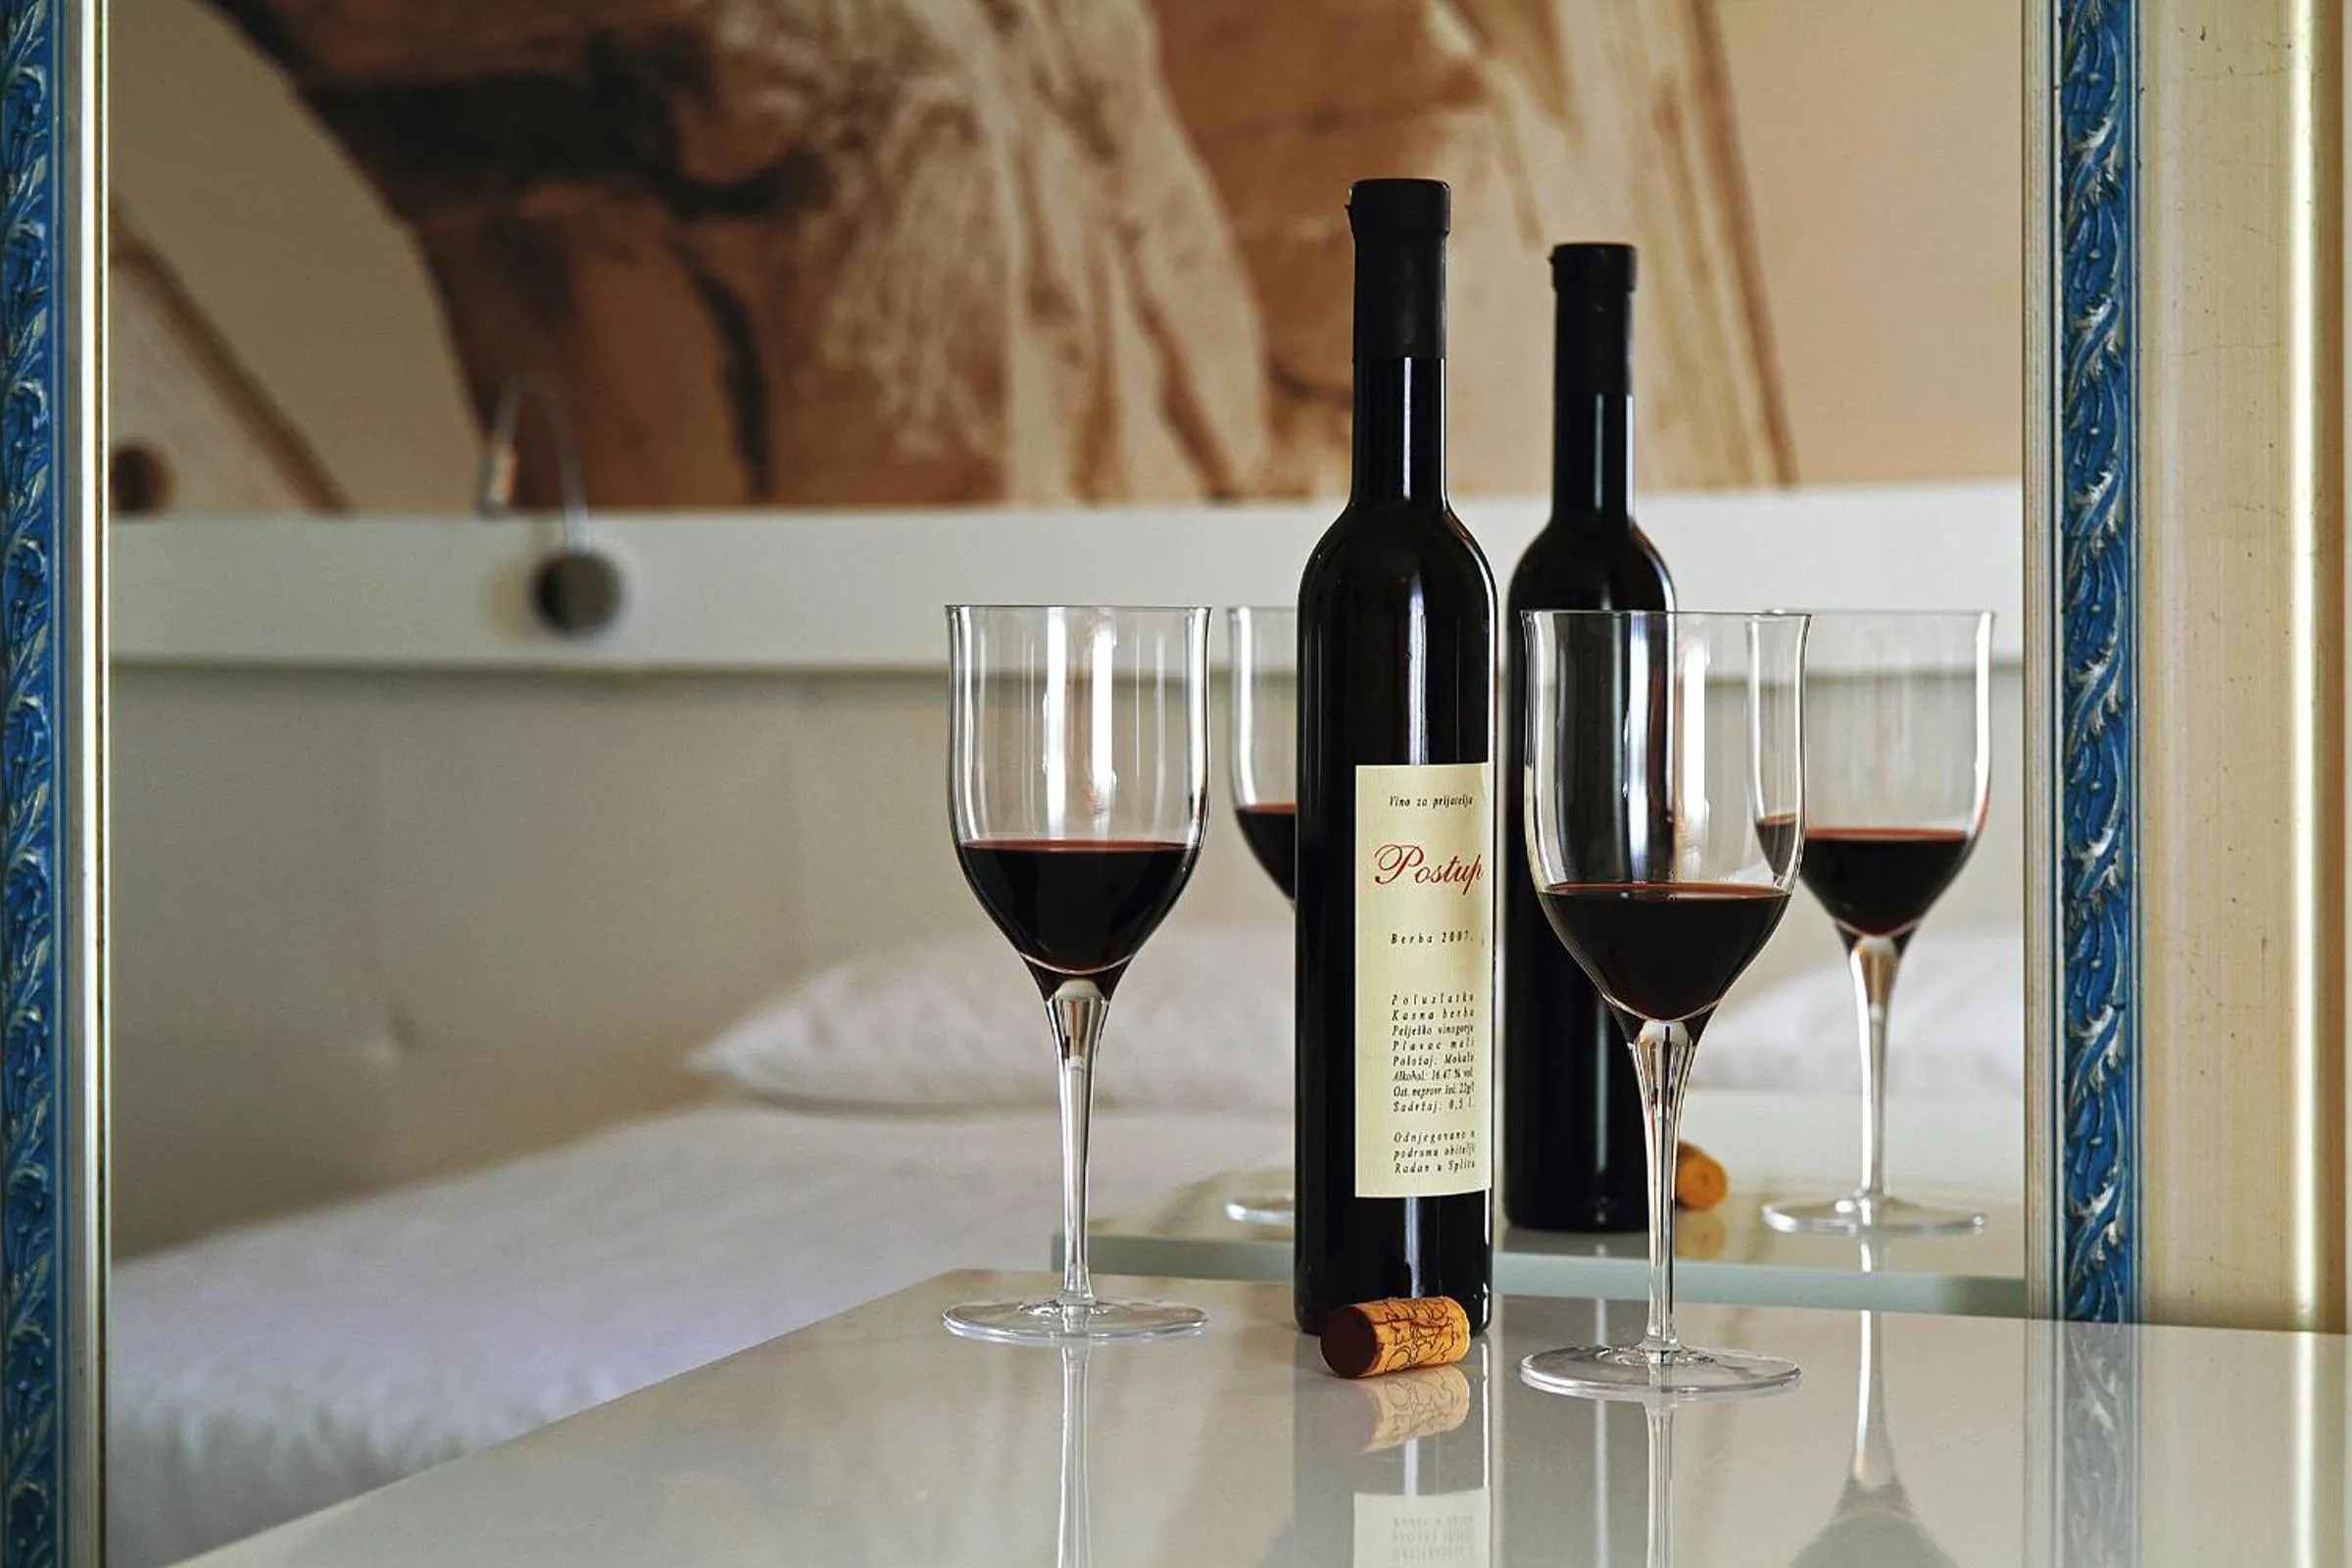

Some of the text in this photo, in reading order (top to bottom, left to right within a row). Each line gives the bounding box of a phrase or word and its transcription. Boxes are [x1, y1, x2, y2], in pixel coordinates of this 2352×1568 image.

[1390, 795, 1410, 807] Vino
[1417, 798, 1428, 807] za
[1374, 844, 1484, 896] Postup
[1391, 933, 1432, 945] Berba
[1392, 992, 1474, 1005] Poluslatko
[1392, 1009, 1434, 1021] Kasna
[1392, 1040, 1442, 1052] Plavac
